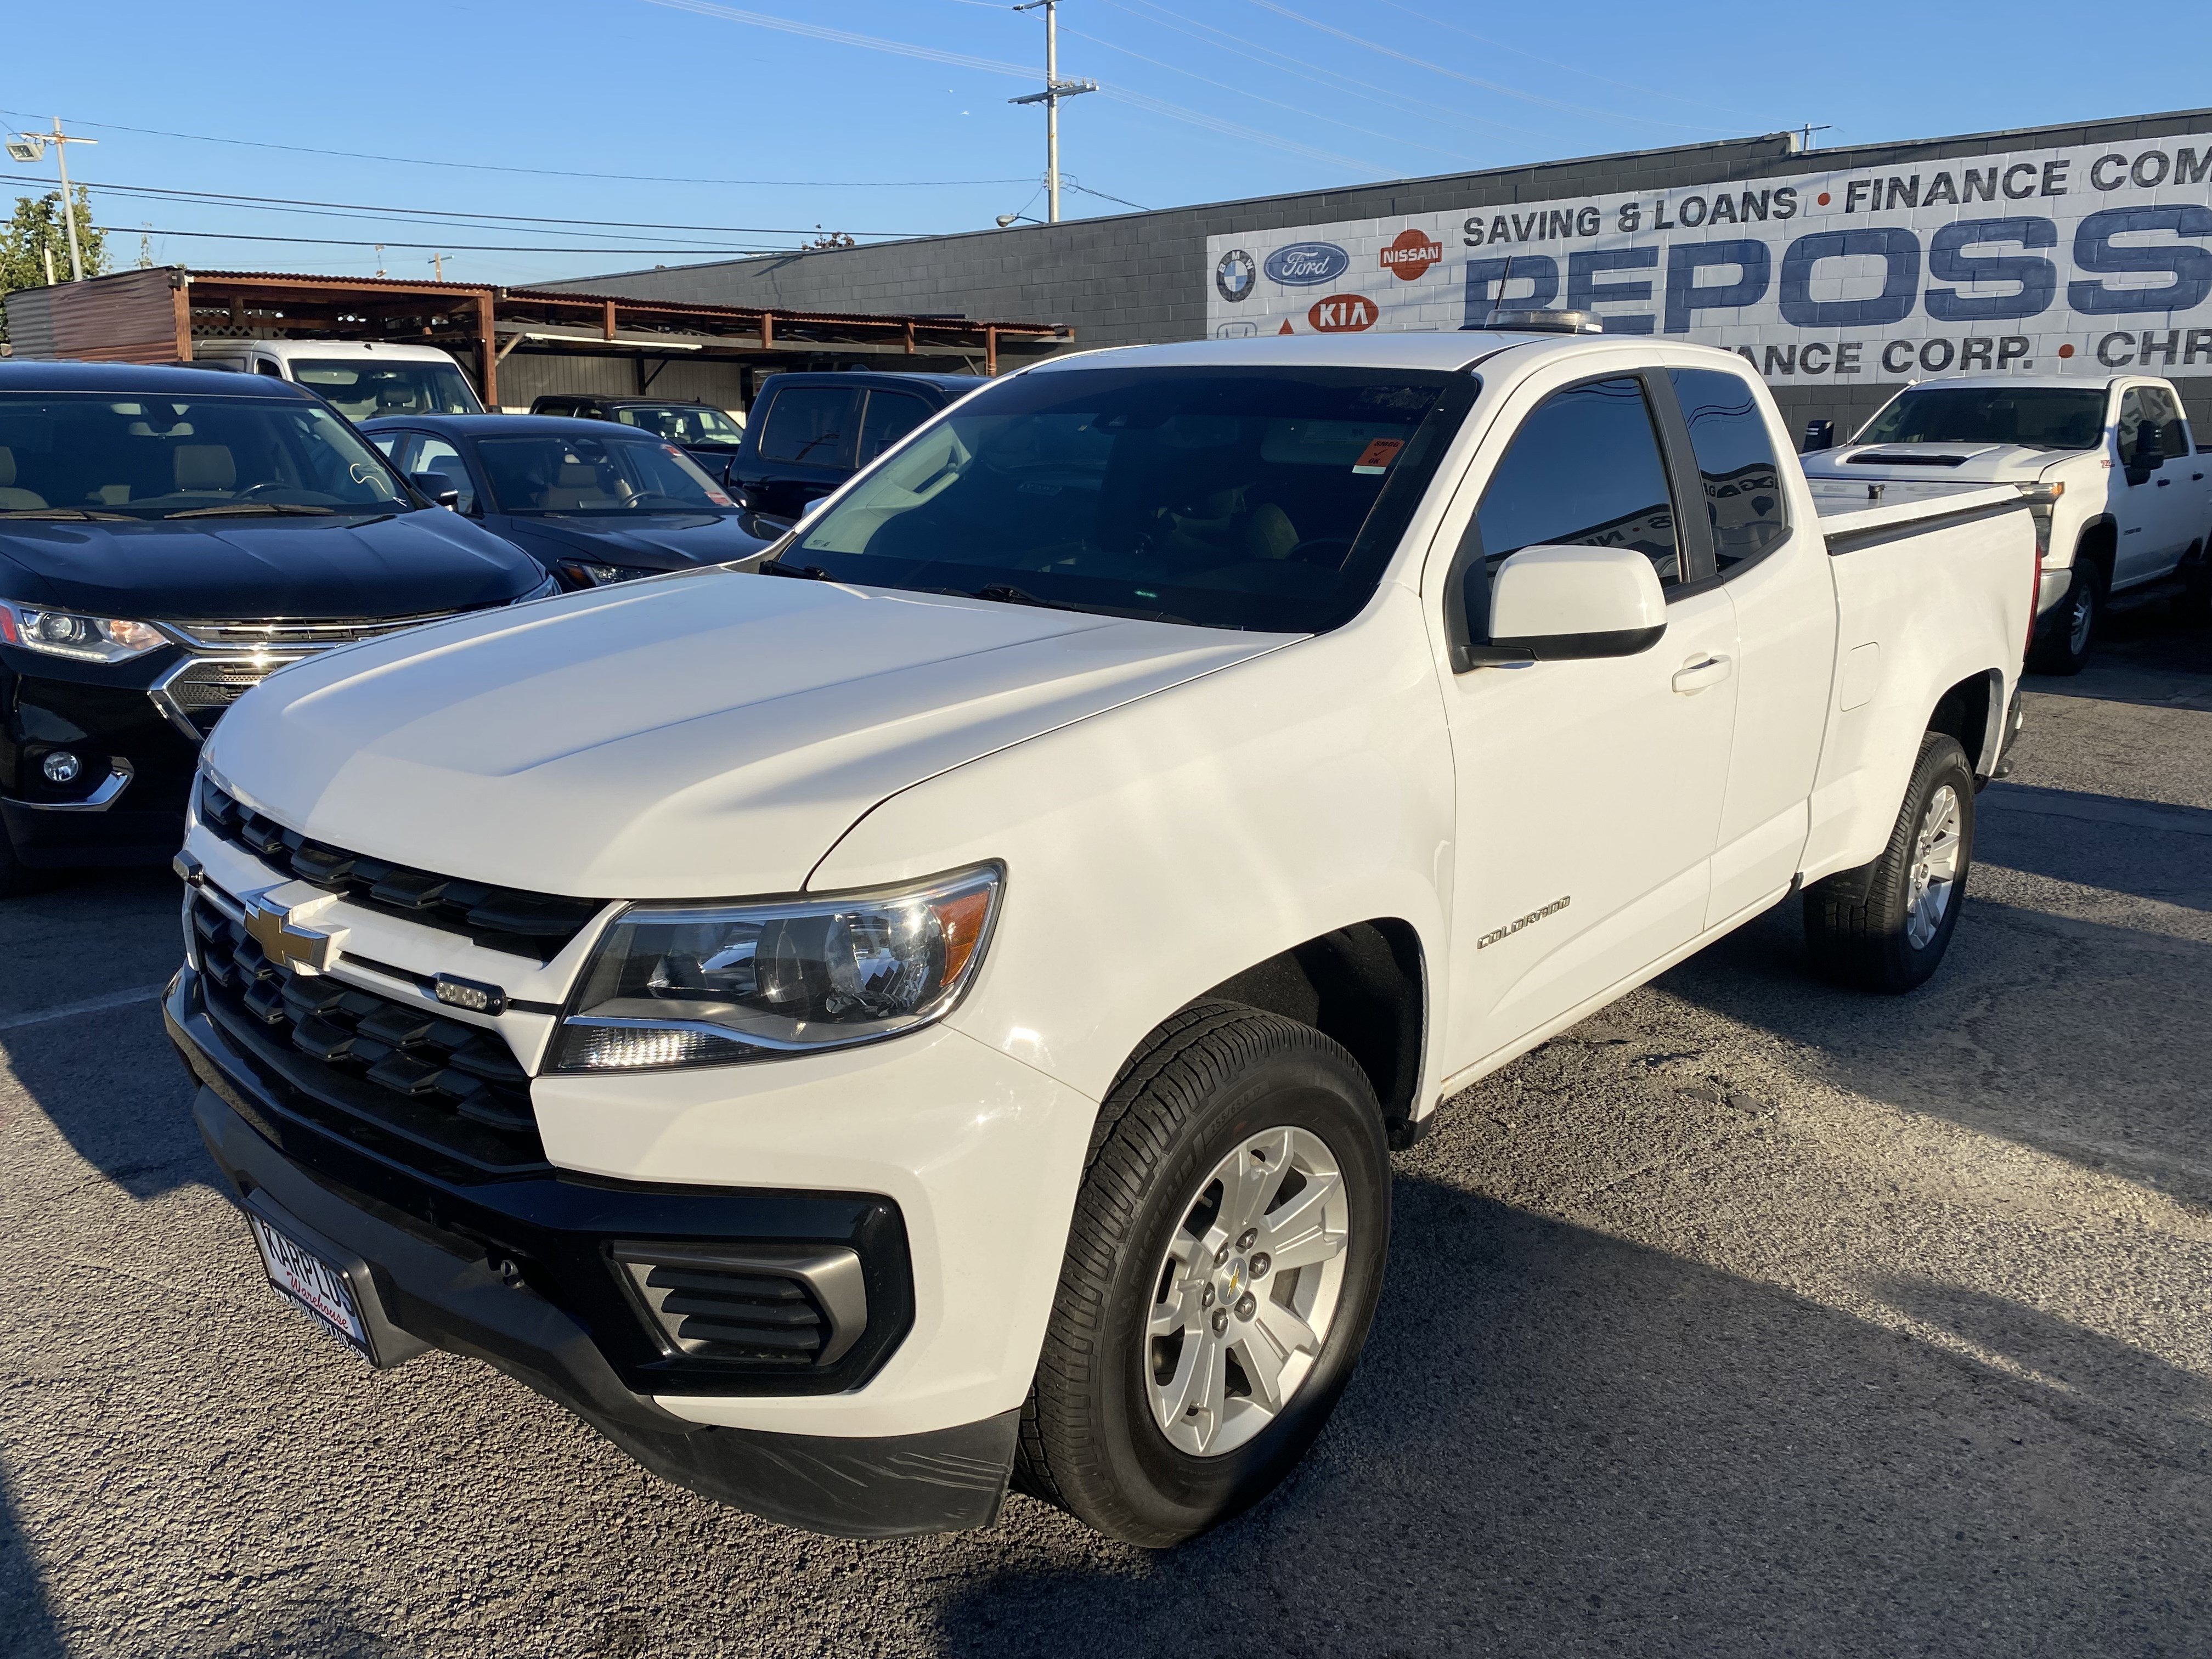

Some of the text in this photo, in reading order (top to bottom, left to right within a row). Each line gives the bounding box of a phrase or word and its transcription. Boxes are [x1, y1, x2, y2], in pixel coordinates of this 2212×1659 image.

[1463, 206, 1600, 246] SAVING
[1618, 202, 1641, 233] &
[1655, 187, 1798, 230] LOANS
[1845, 159, 2072, 214] FINANCE
[1218, 250, 1255, 274] BMW
[1282, 251, 1330, 276] Ford
[1383, 246, 1440, 264] NISSAN
[1319, 301, 1368, 327] KIA
[1882, 336, 2033, 374] CORP.
[1477, 895, 1571, 950] COLORADO
[260, 1219, 356, 1317] KARPLUS
[286, 1271, 349, 1329] Warehouse
